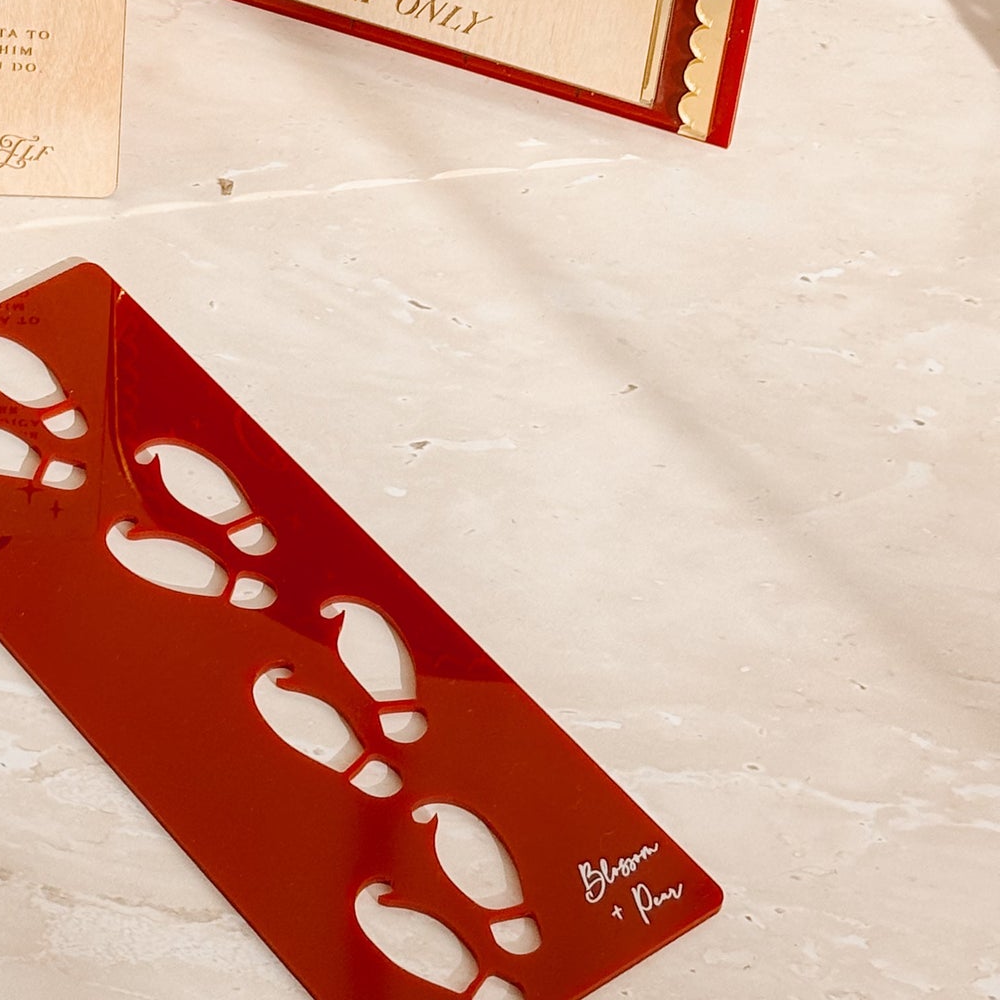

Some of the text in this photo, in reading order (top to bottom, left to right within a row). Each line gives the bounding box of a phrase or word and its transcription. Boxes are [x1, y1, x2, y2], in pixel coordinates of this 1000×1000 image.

[25, 29, 50, 40] TO
[578, 842, 659, 903] Blossom
[611, 883, 683, 925] + Pear
